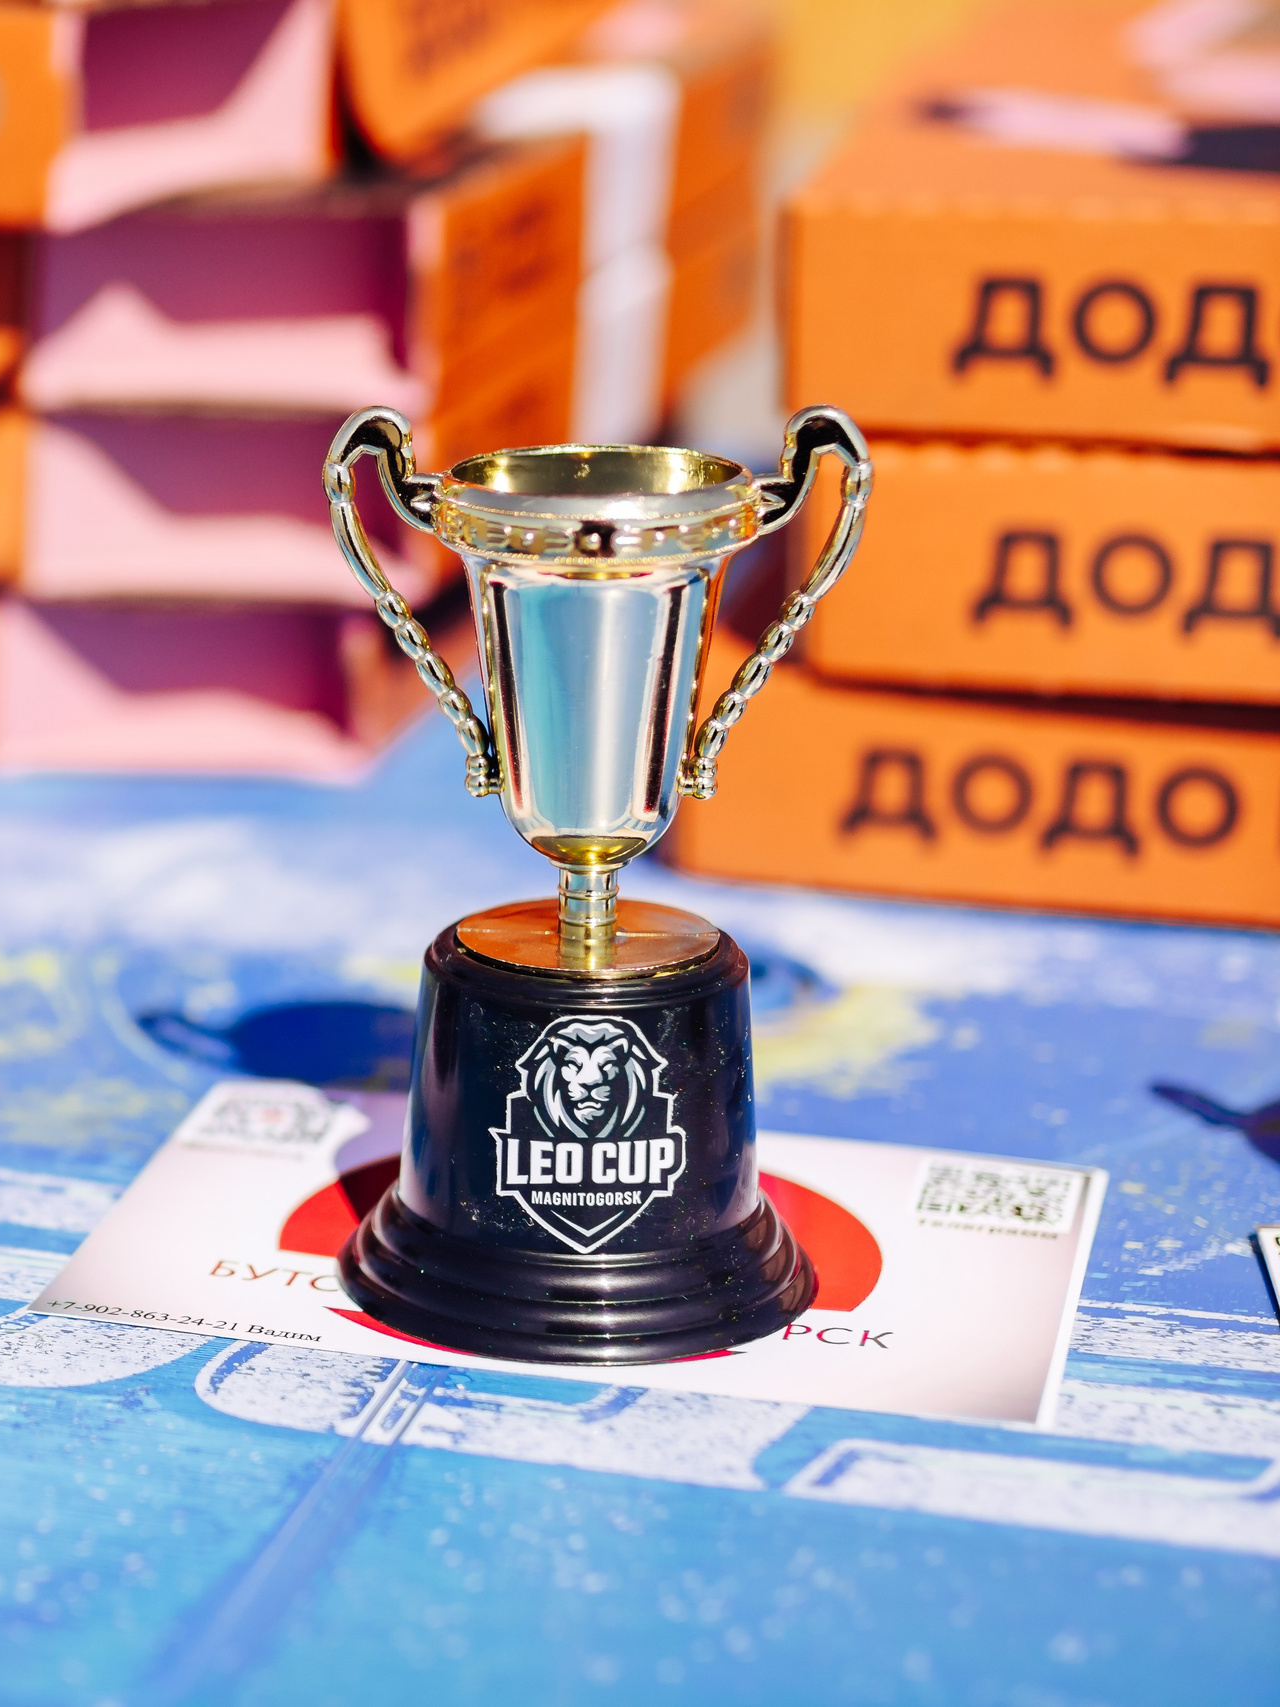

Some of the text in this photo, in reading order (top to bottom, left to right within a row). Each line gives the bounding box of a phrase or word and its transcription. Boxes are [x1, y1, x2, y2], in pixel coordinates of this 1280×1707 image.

[951, 277, 1272, 388] ДОД
[971, 530, 1280, 638] ДОД
[838, 748, 1241, 858] ДОДО
[506, 1138, 676, 1184] LEO CUP
[531, 1190, 642, 1206] MAGNITOGORSK
[46, 1300, 322, 1343] +7-902-863-24-21 Вадим
[209, 1260, 895, 1349] БУТС РСК
